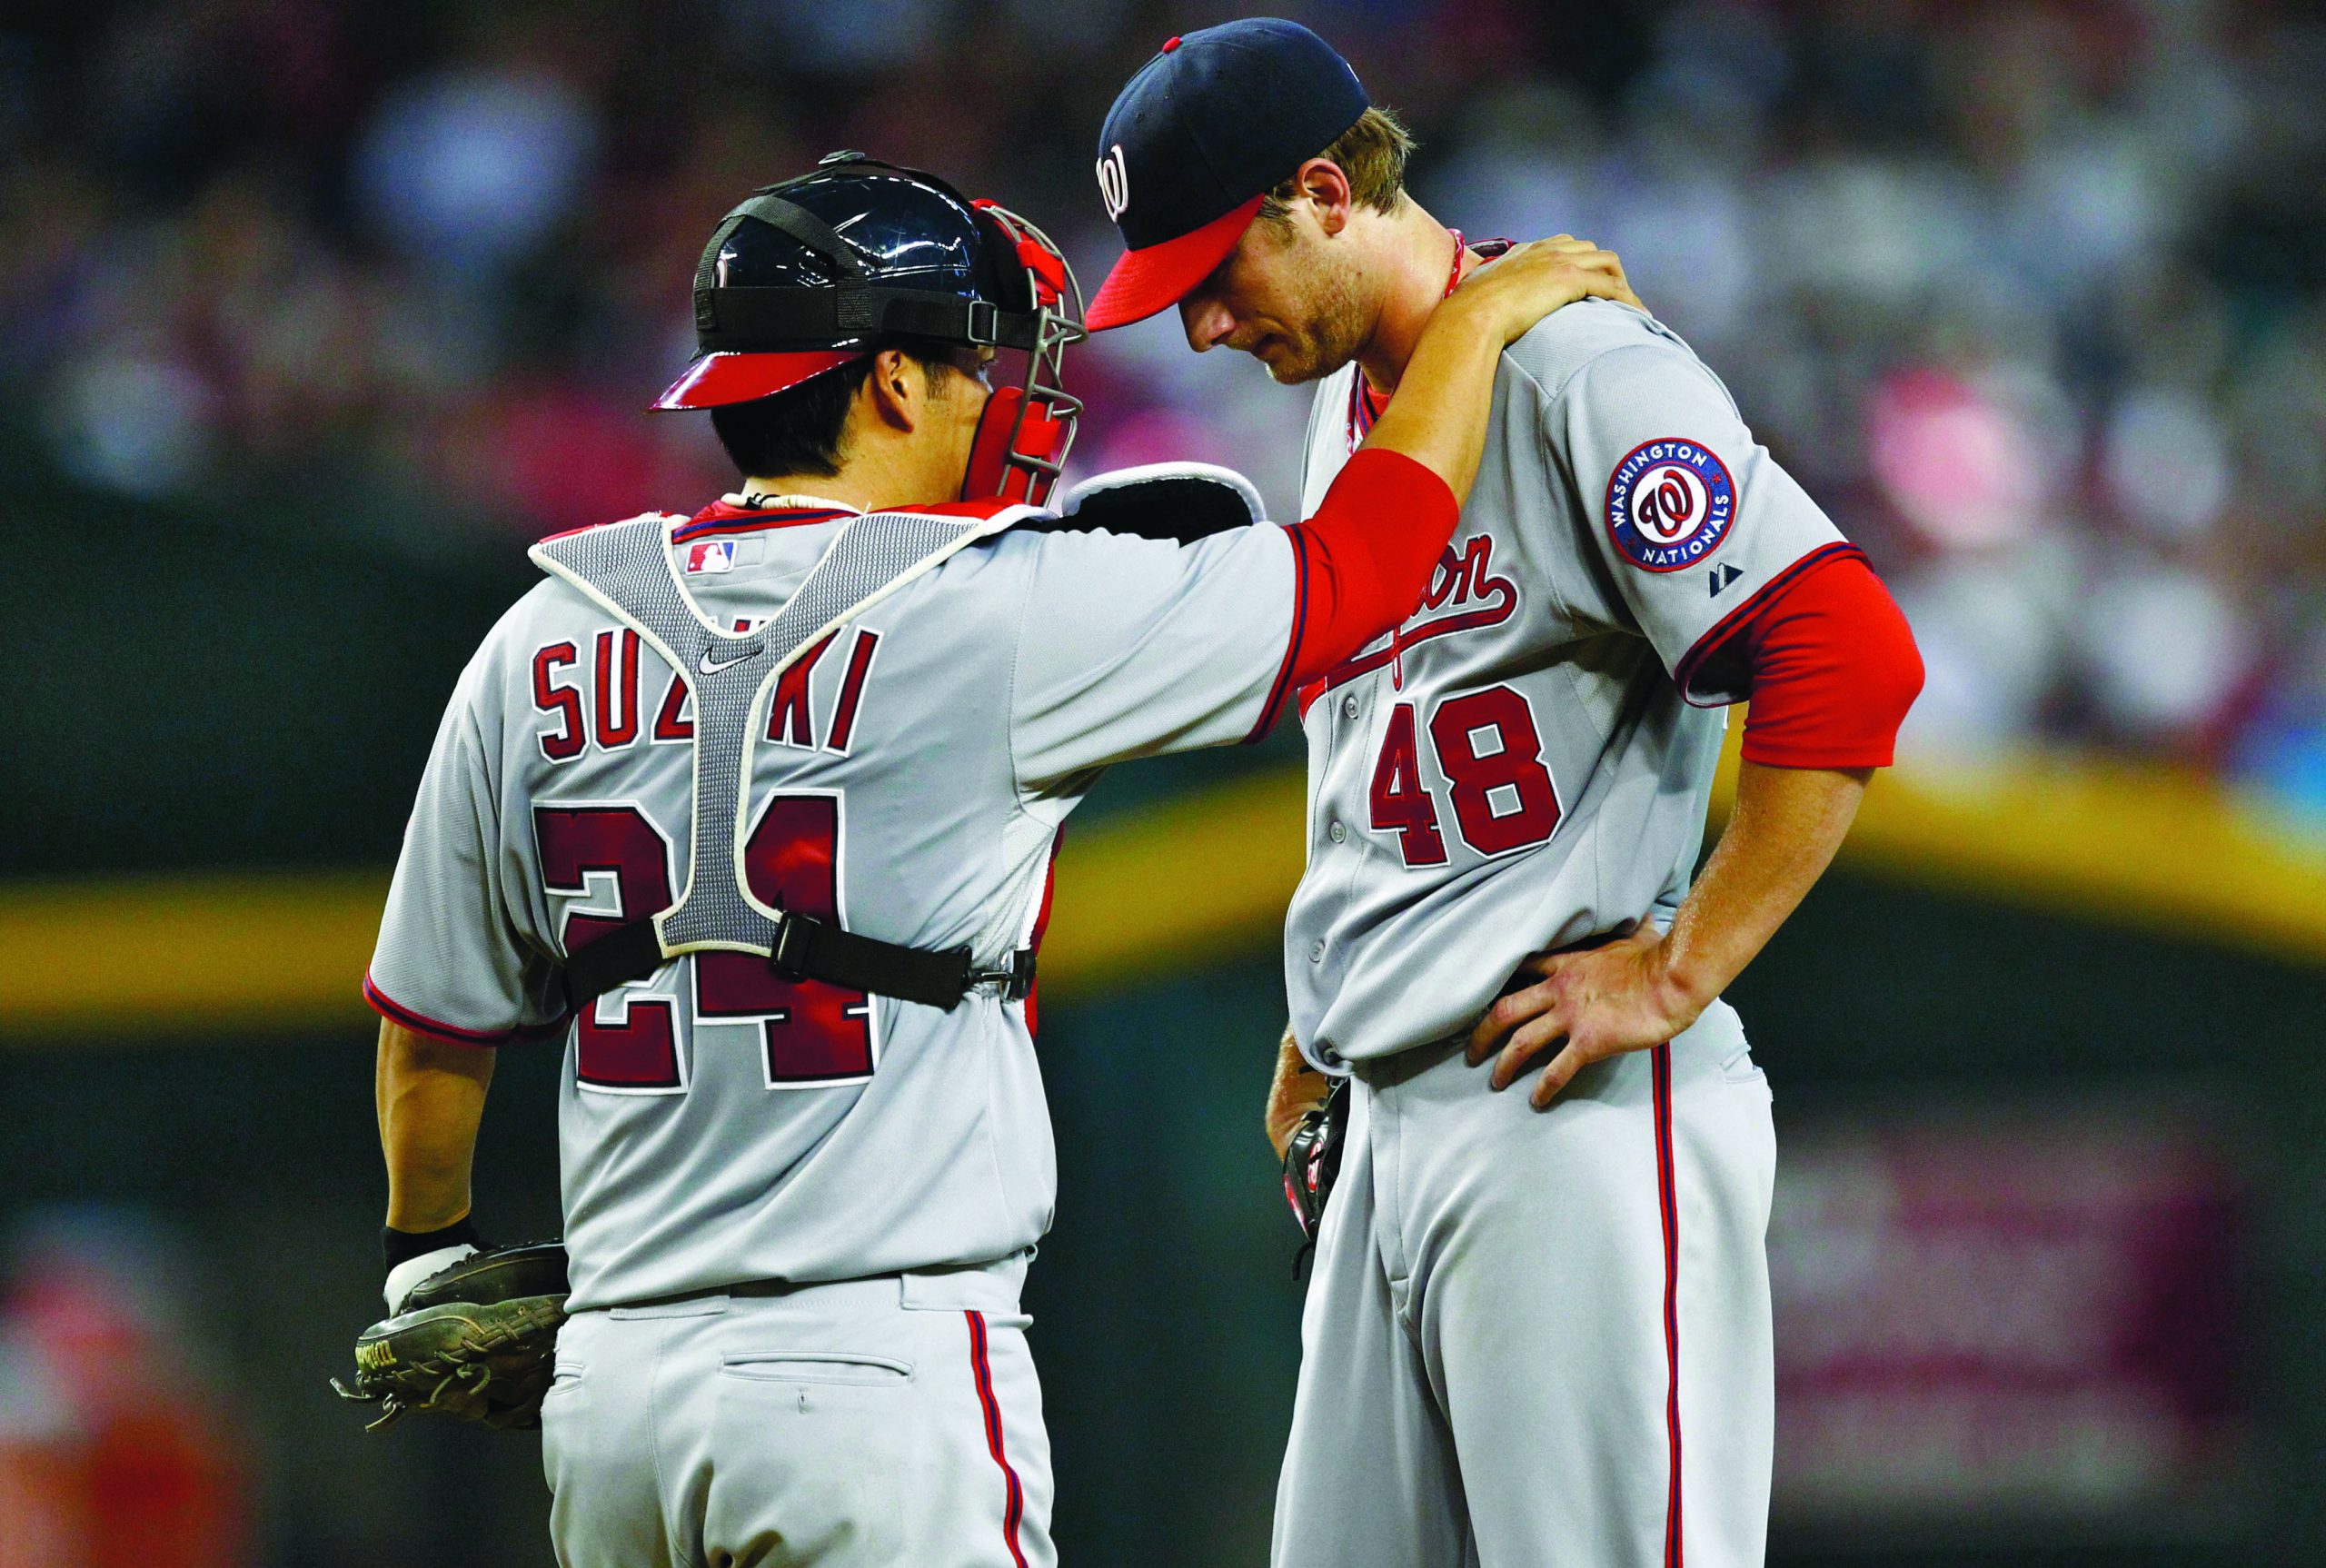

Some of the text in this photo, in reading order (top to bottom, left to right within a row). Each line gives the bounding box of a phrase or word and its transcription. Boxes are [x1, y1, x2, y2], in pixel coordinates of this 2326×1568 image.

[1611, 443, 1708, 529] WASHINGTON
[1643, 494, 1730, 565] NATIONALS
[530, 614, 884, 765] SUKI
[1368, 681, 1565, 869] 48
[531, 788, 880, 1096] 24
